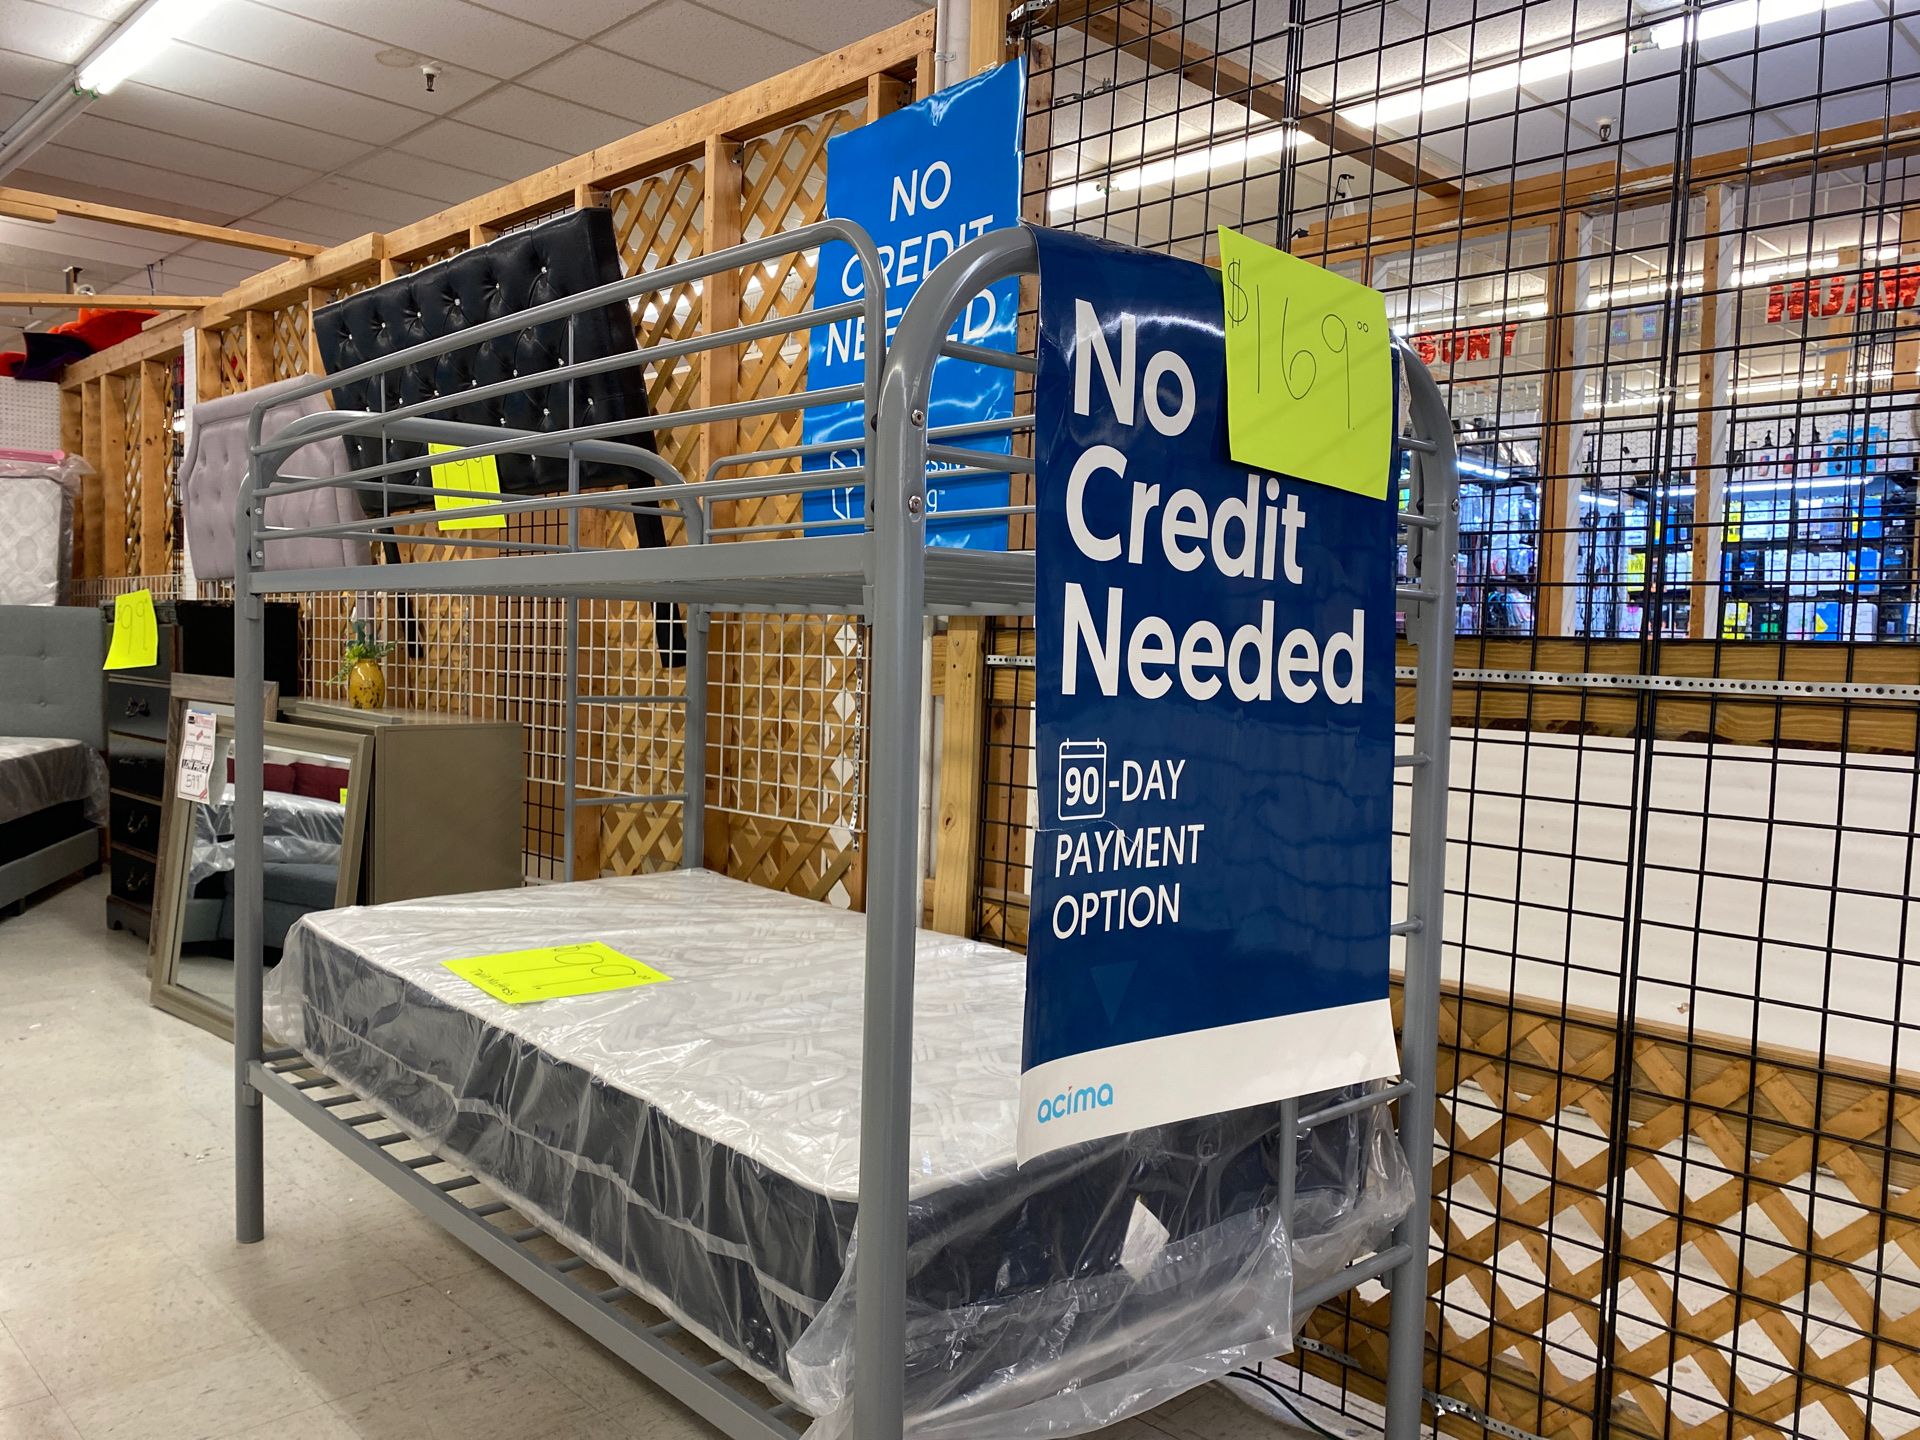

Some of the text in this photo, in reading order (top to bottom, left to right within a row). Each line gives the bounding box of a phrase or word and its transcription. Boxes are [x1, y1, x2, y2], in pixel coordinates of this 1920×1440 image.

[890, 161, 951, 222] NO
[1073, 298, 1196, 436] No
[1066, 444, 1306, 584] Credit
[1062, 582, 1365, 705] Needed
[1055, 823, 1205, 878] PAYMENT
[1052, 882, 1181, 940] OPTION
[1037, 1083, 1114, 1124] acima
